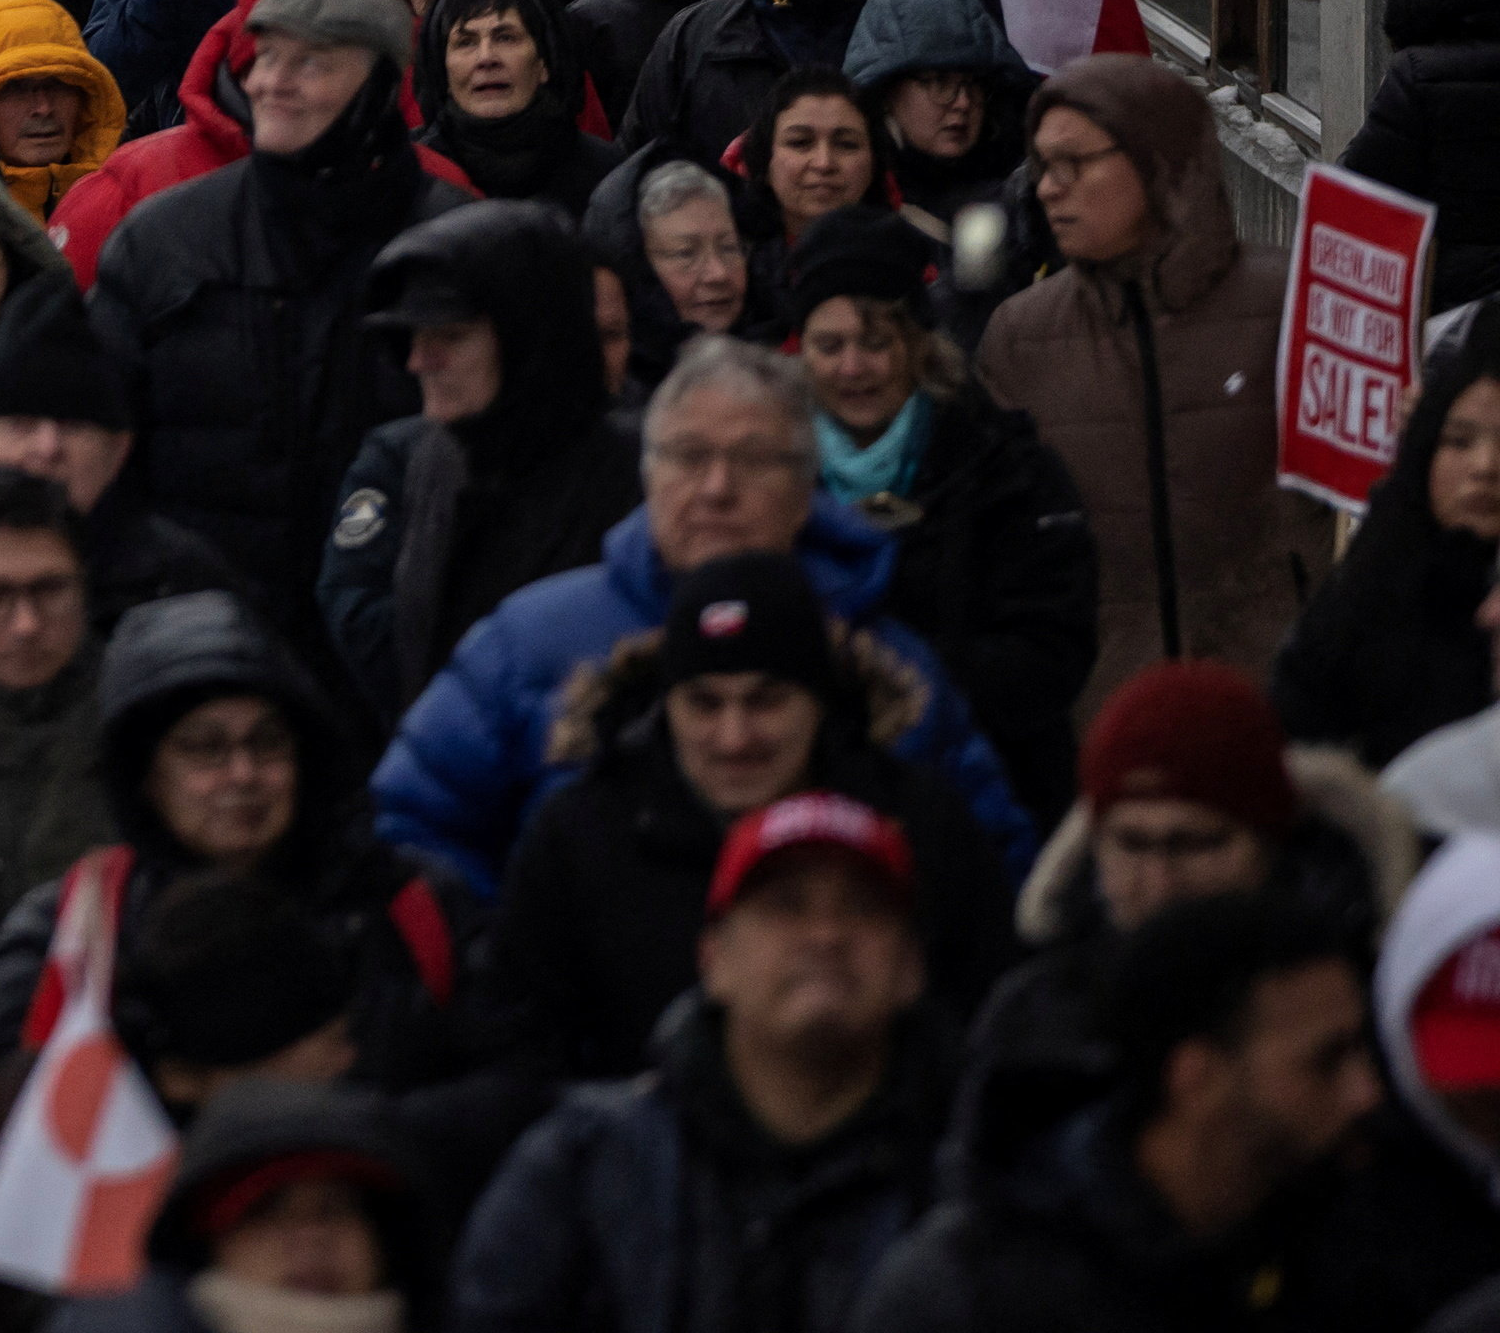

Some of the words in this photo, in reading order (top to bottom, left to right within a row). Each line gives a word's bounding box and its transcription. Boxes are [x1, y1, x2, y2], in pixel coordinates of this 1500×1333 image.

[1313, 229, 1398, 297] GREENLAND
[1309, 289, 1326, 328] IS
[1330, 300, 1354, 343] NOT
[1362, 312, 1397, 356] FOR
[1301, 352, 1397, 457] SALE!
